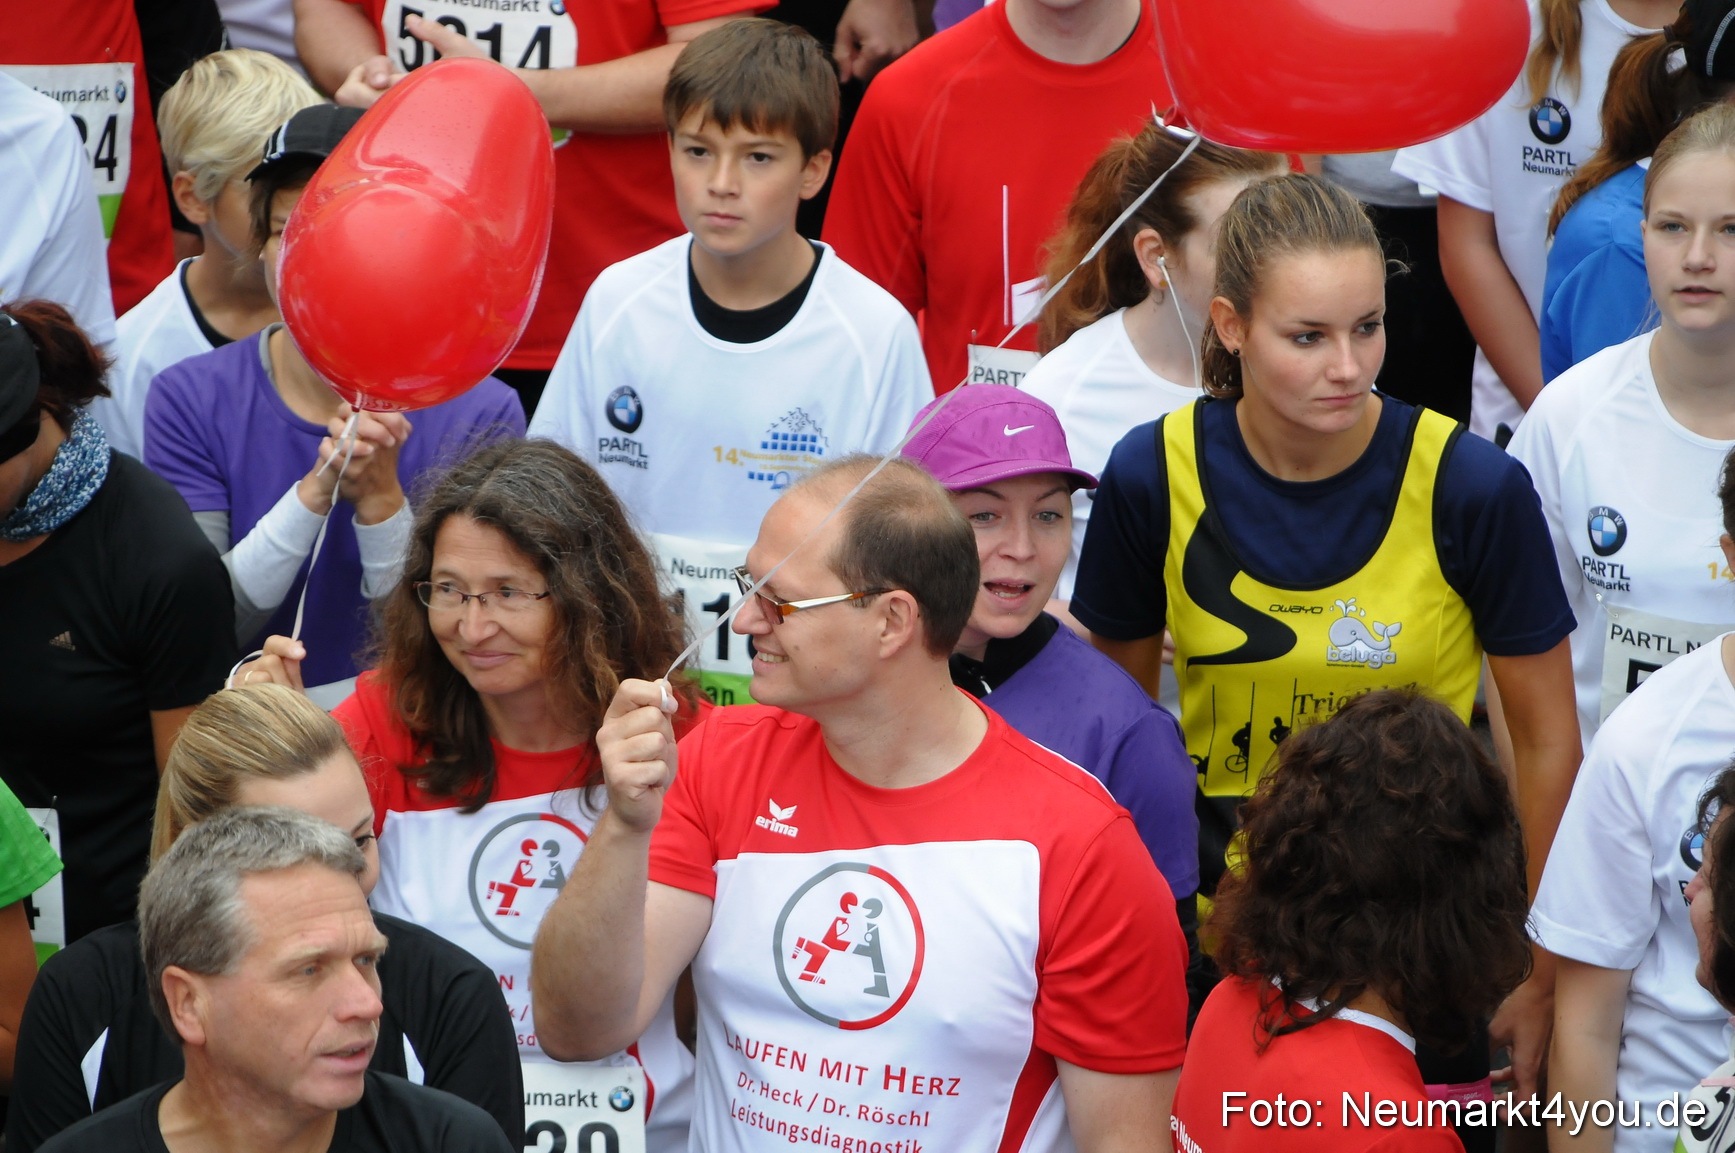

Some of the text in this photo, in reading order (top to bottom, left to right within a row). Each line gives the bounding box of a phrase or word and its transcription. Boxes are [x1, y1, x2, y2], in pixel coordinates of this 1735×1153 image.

[1522, 145, 1577, 166] PARTL
[973, 365, 1027, 388] PART
[598, 437, 648, 459] PARTL
[599, 453, 648, 470] Neumarkt
[671, 557, 738, 581] Neuma
[1582, 555, 1631, 581] PARTL
[1610, 622, 1680, 655] PARTL
[1326, 645, 1397, 670] beluga
[755, 815, 799, 838] erima
[723, 1021, 961, 1096] LAUFEN MIT HERZ
[737, 1071, 755, 1093] Dr.
[759, 1081, 803, 1107] Heck
[823, 1097, 850, 1118] Dr.
[857, 1104, 930, 1127] Röschl
[731, 1098, 923, 1153] Leistungsdiagnostik
